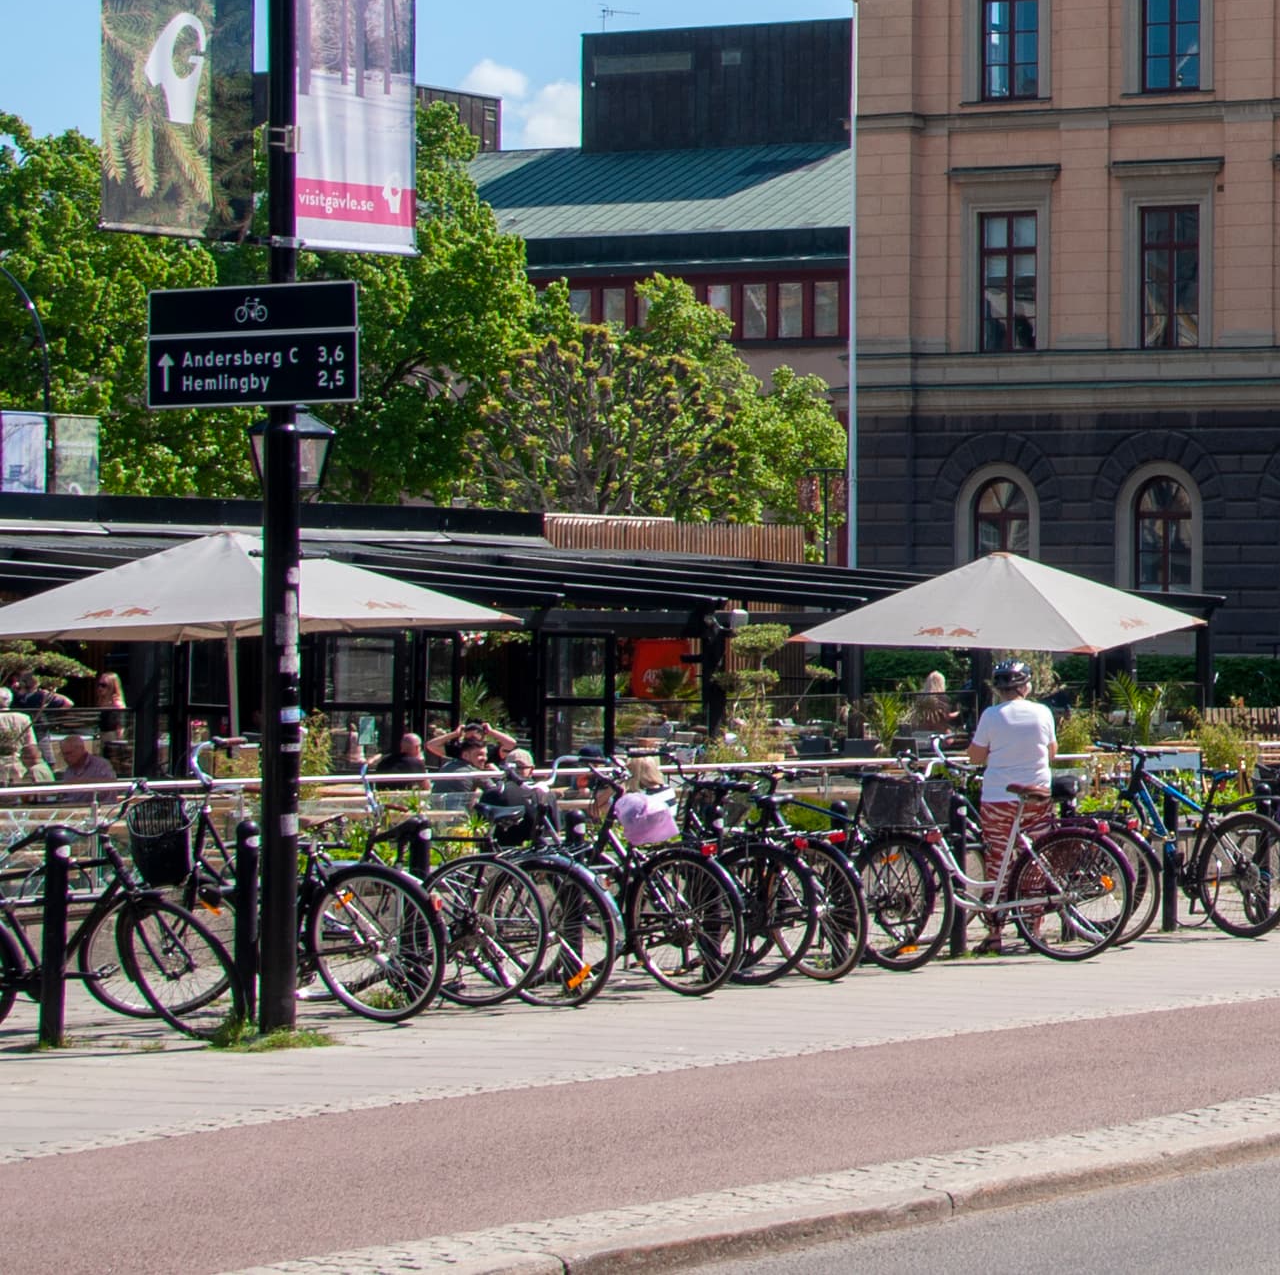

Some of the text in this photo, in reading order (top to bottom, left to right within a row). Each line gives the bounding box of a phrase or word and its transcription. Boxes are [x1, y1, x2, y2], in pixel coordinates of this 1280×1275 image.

[298, 188, 375, 214] visitgävle.se
[181, 345, 345, 368] Andersberg C 3,6
[181, 370, 345, 393] Hemlingby 2,5
